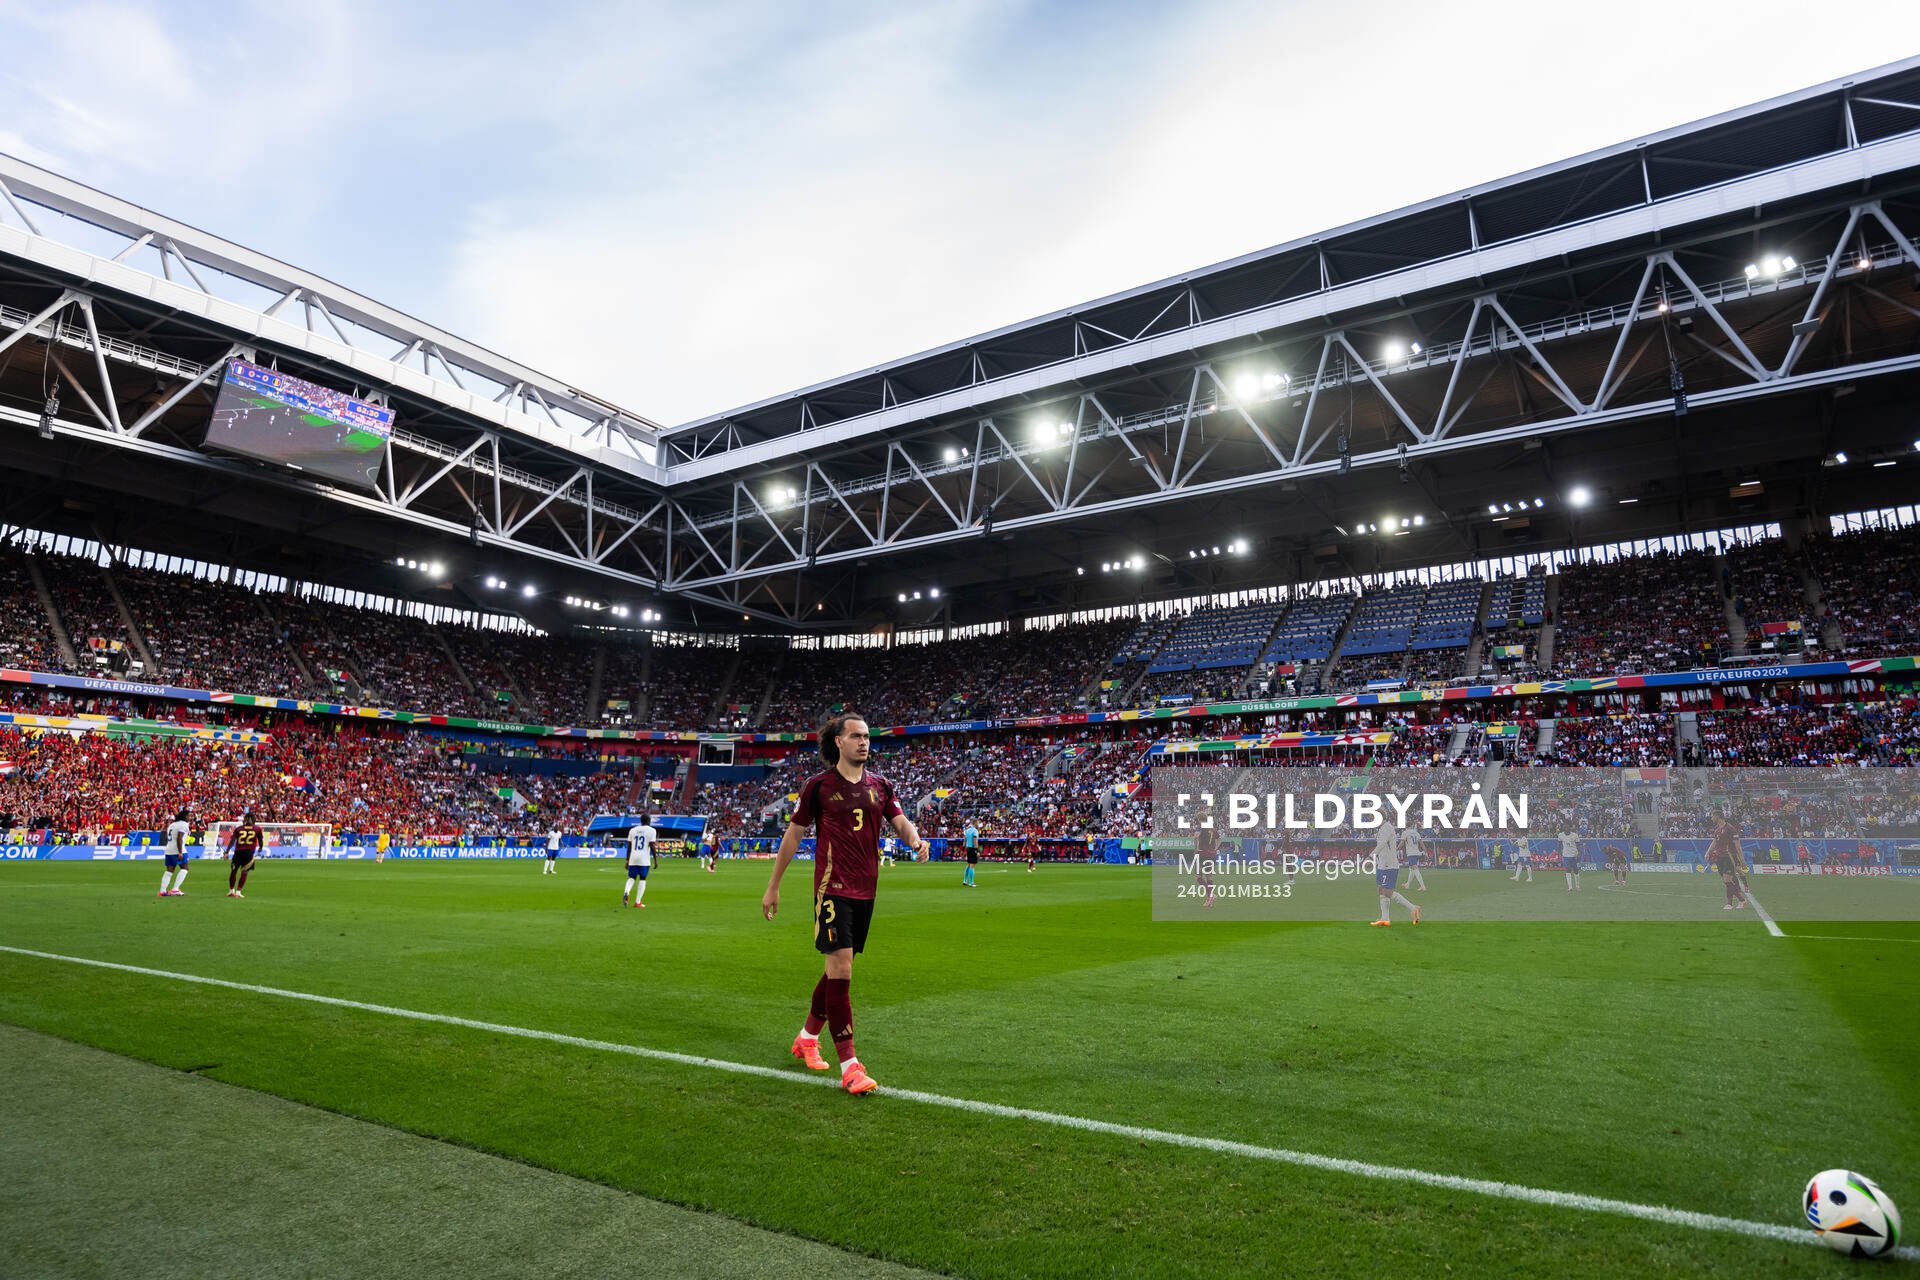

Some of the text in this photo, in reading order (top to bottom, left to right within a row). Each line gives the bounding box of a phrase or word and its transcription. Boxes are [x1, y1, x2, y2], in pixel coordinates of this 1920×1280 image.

[1241, 701, 1300, 711] DÜSSELDORF
[852, 808, 864, 832] 3
[237, 830, 257, 845] 22
[634, 835, 646, 851] 13
[1148, 839, 1196, 847] DÜSSELD
[400, 847, 549, 858] NO.1 NEV MAKER BYD.CO
[1633, 863, 1690, 873] Hisense
[822, 899, 836, 924] 3
